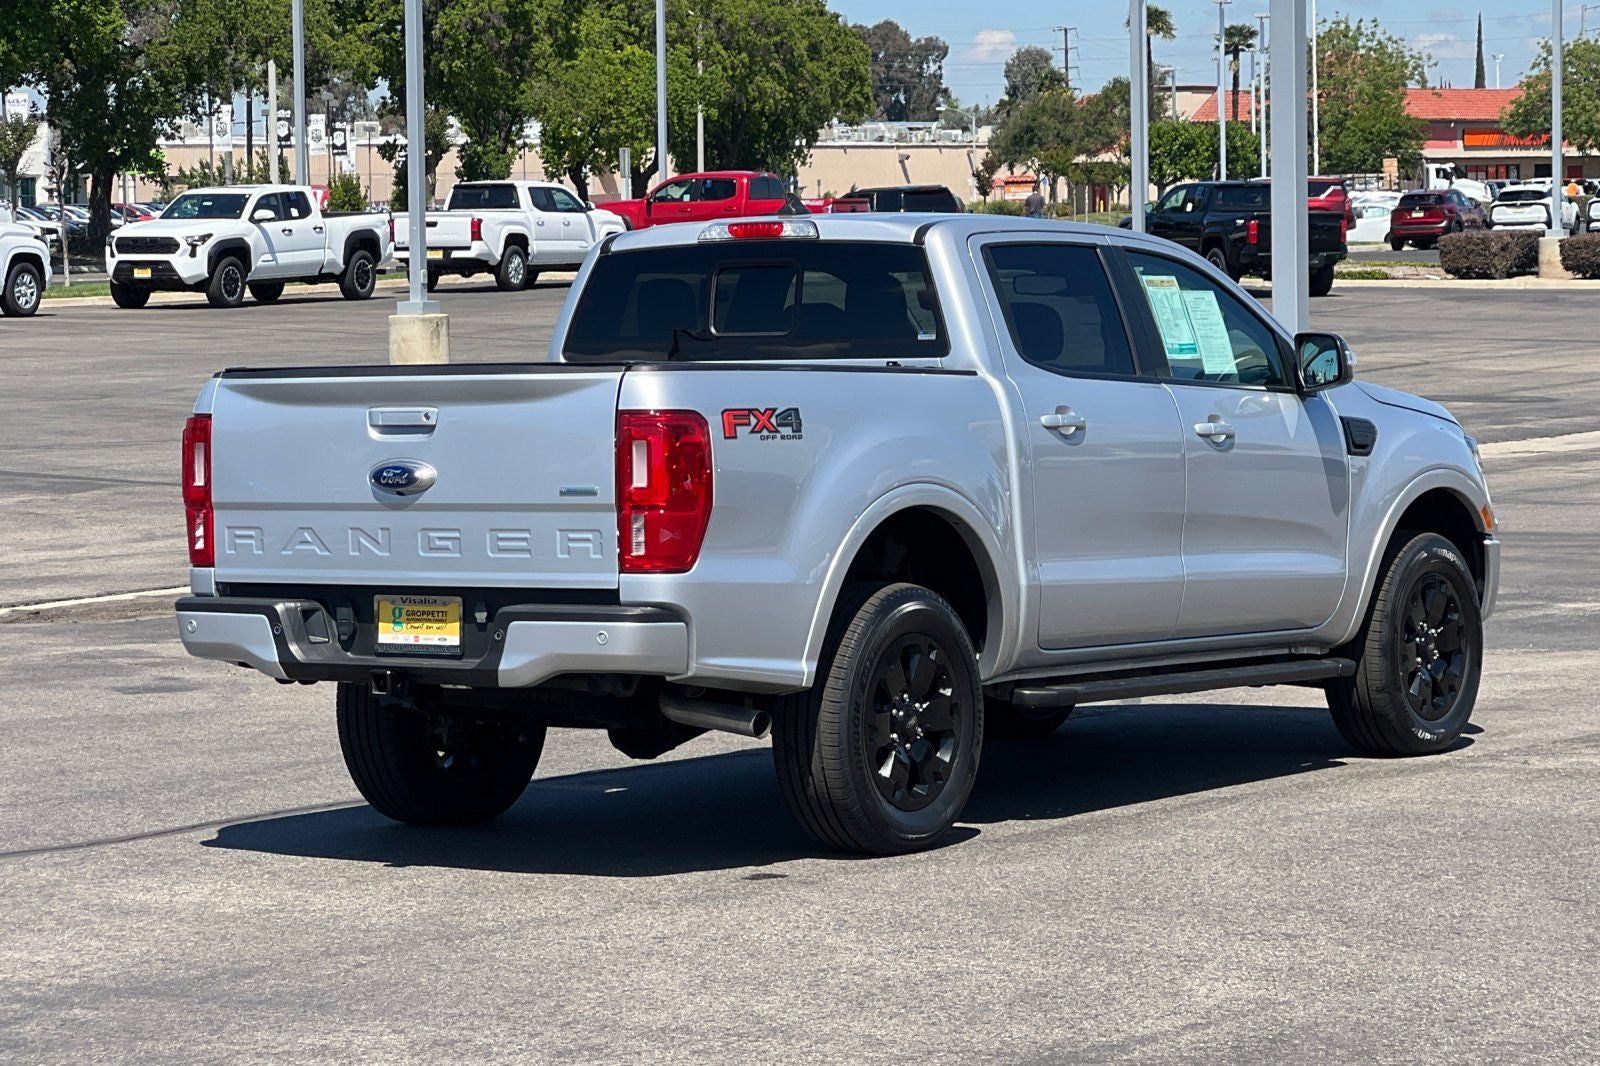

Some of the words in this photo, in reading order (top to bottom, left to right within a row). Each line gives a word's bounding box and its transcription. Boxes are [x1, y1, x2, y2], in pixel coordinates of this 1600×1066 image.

[721, 408, 802, 439] FX4
[380, 469, 409, 484] Ford
[225, 526, 603, 559] RANGER
[400, 596, 437, 605] Visalia
[405, 609, 448, 618] GROPPETTI
